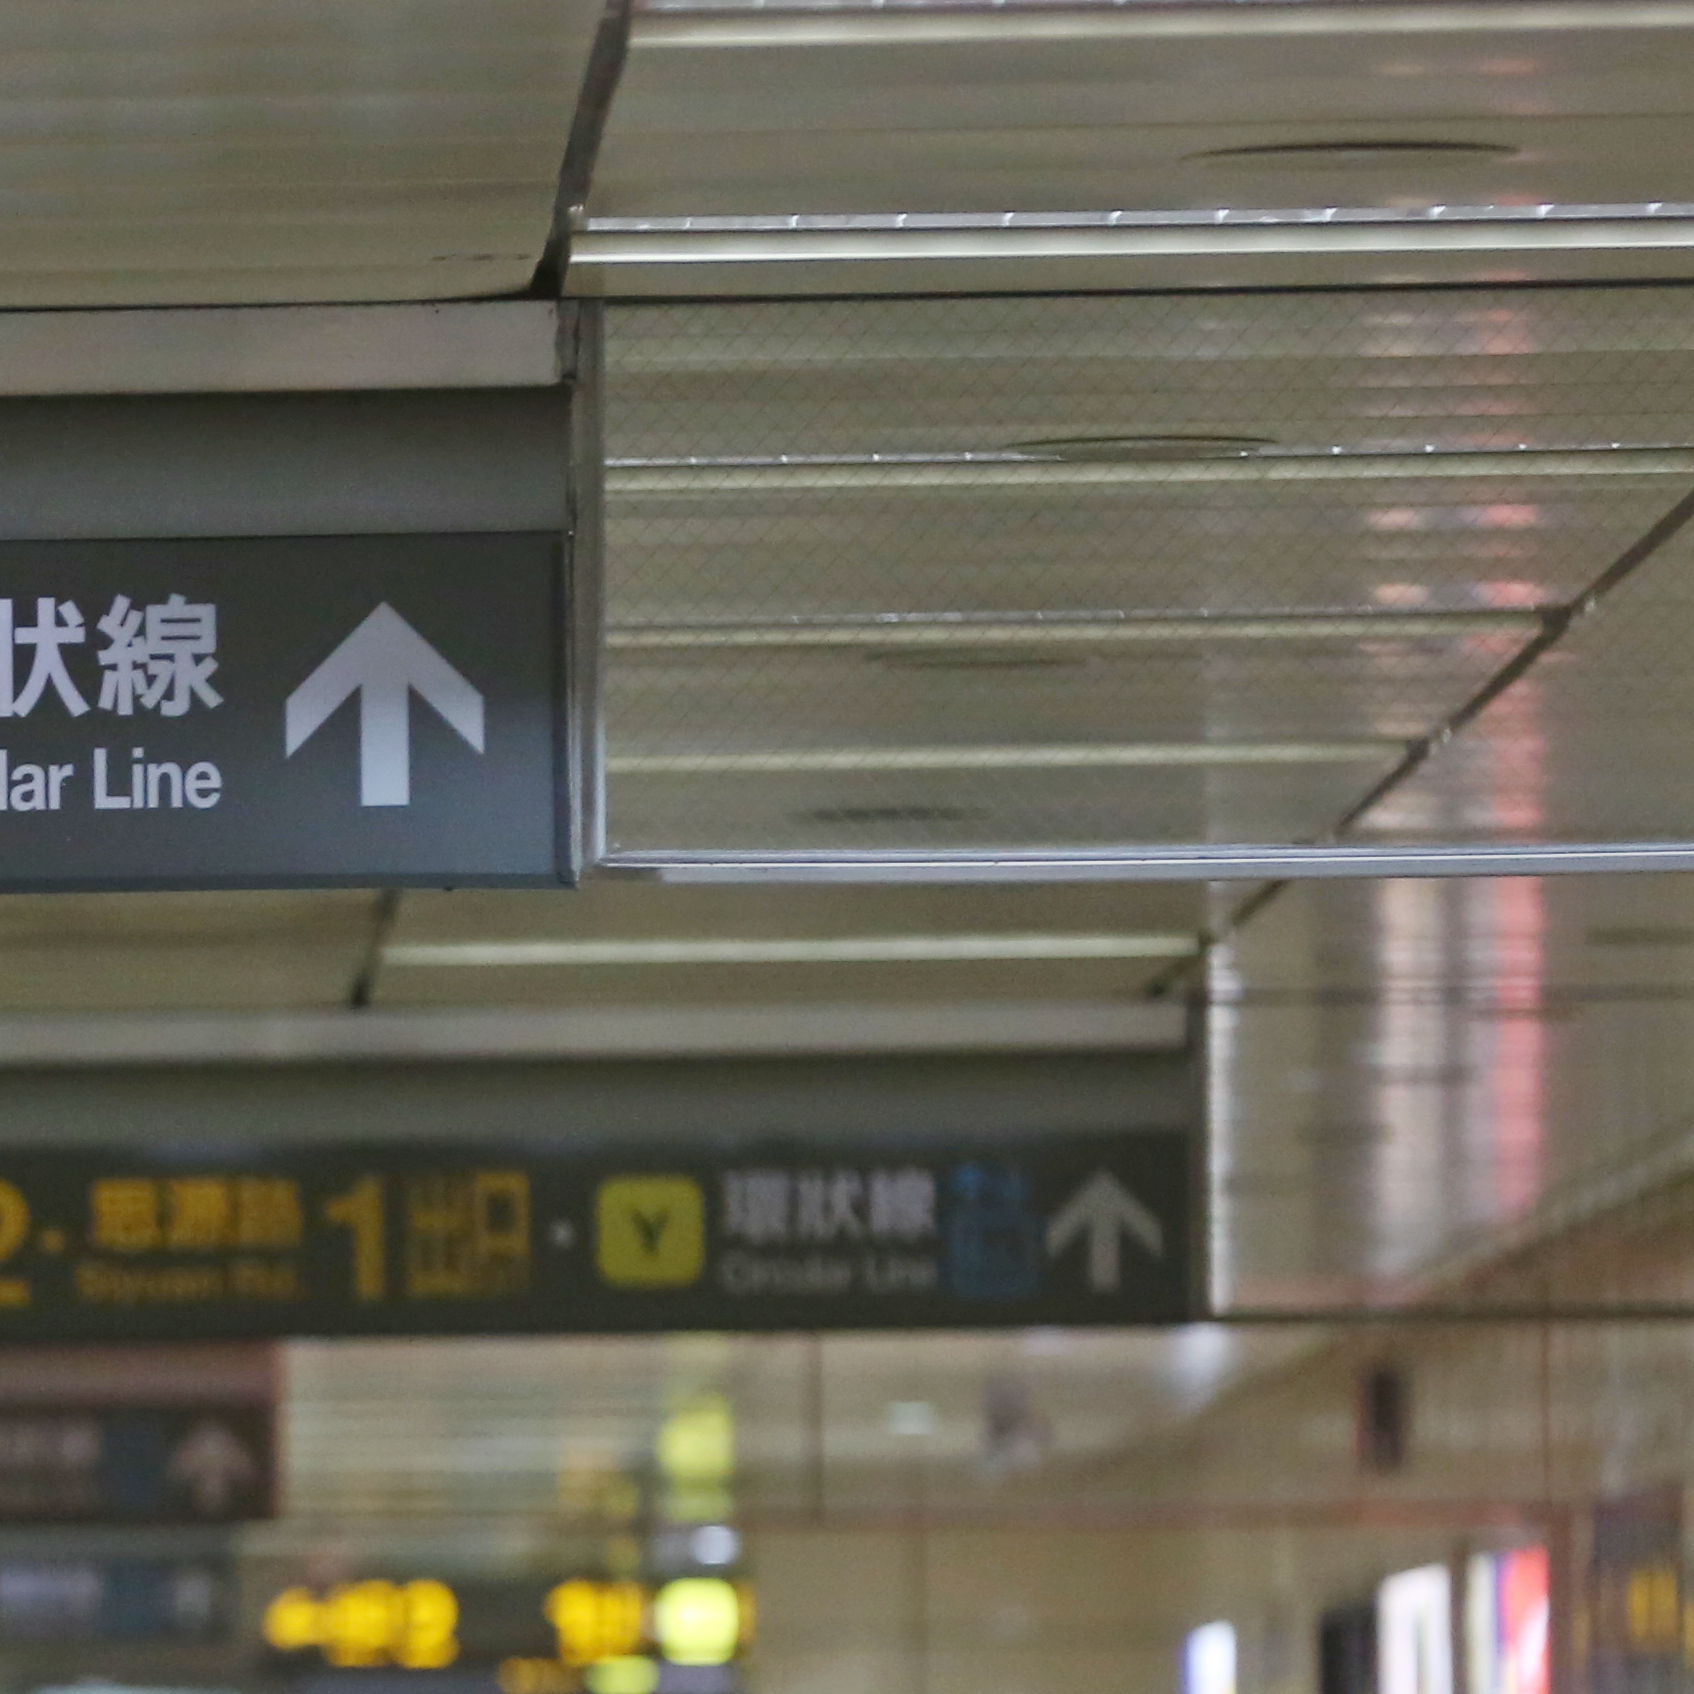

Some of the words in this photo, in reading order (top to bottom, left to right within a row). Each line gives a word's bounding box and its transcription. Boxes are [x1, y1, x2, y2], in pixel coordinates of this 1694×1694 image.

[93, 747, 222, 811] Line
[323, 1180, 387, 1300] 1
[627, 1207, 673, 1261] Y
